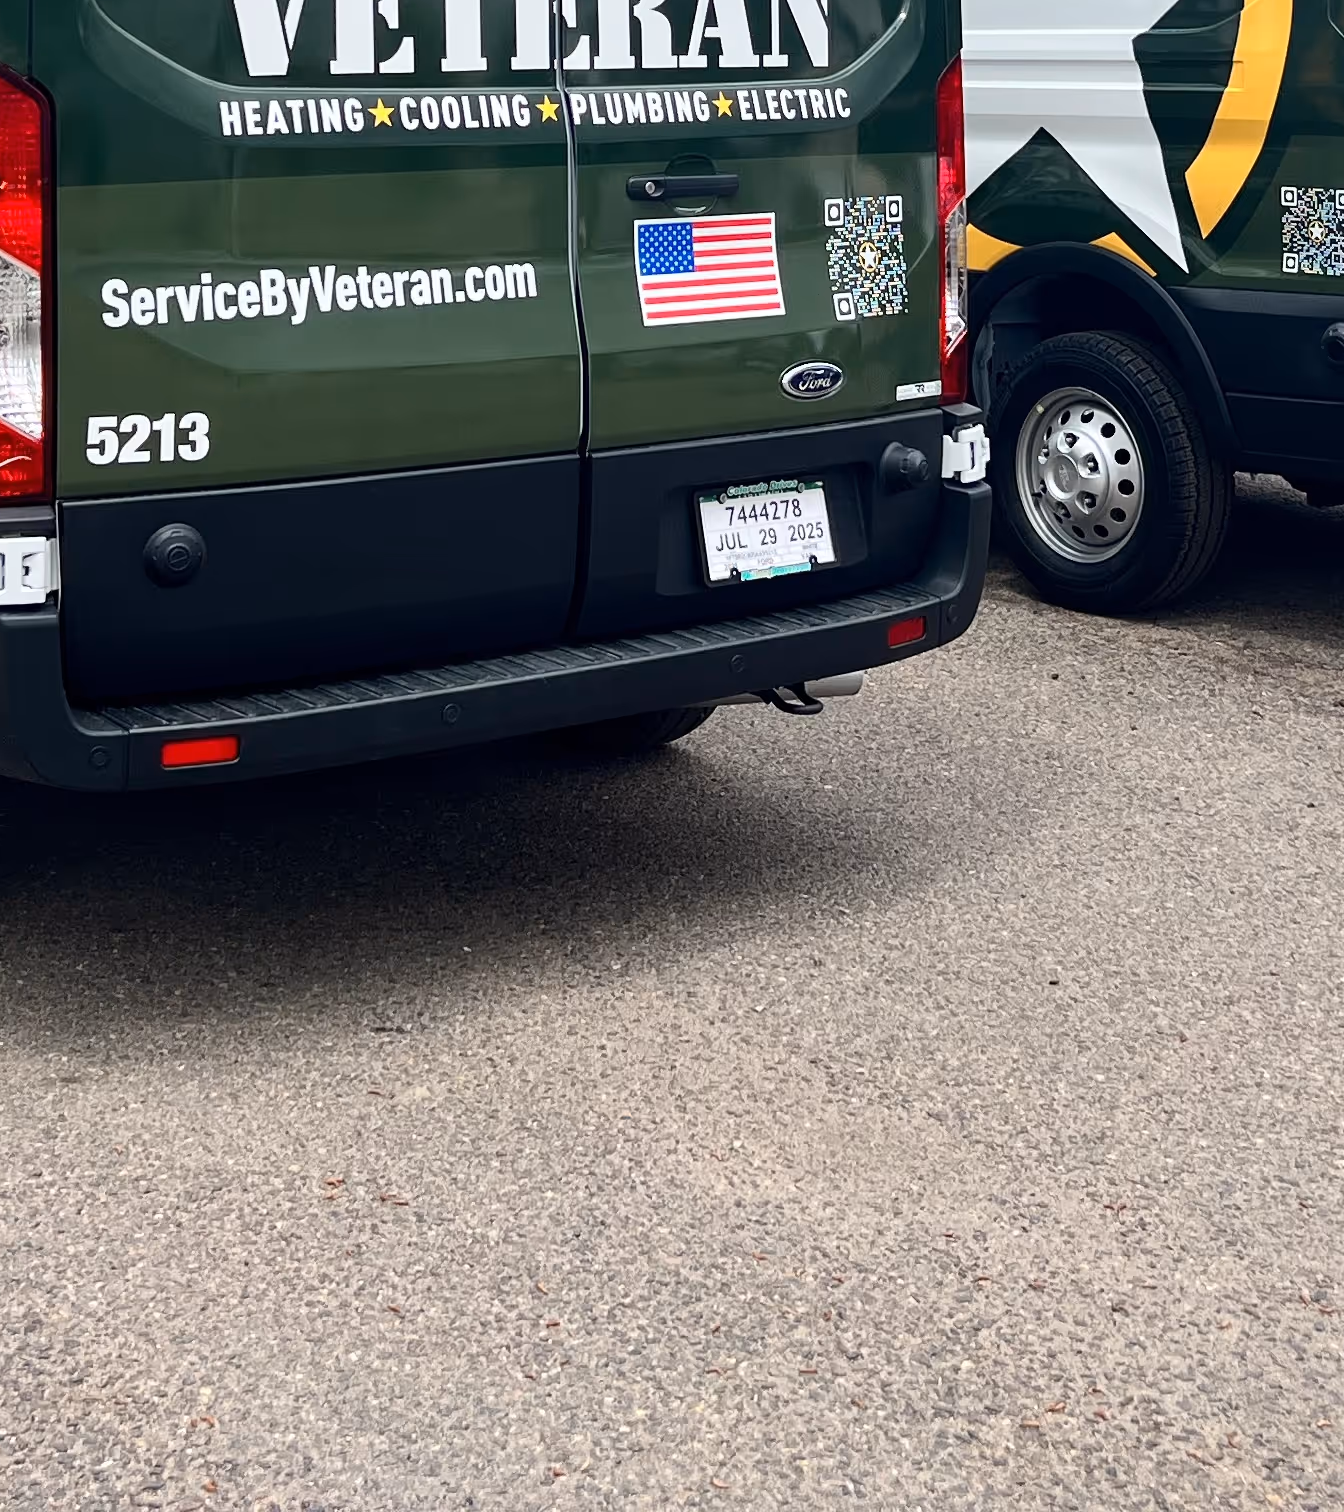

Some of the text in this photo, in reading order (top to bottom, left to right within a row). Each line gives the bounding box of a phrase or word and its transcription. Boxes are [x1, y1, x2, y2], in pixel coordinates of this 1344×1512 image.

[219, 85, 852, 139] HEATING COOLING PLUMBING ELECTRIC
[100, 261, 537, 328] ServiceByVeteran.com
[798, 369, 833, 391] Ford
[86, 411, 211, 465] 5213
[725, 498, 802, 526] 7444278
[716, 521, 824, 552] JUL 29 2025
